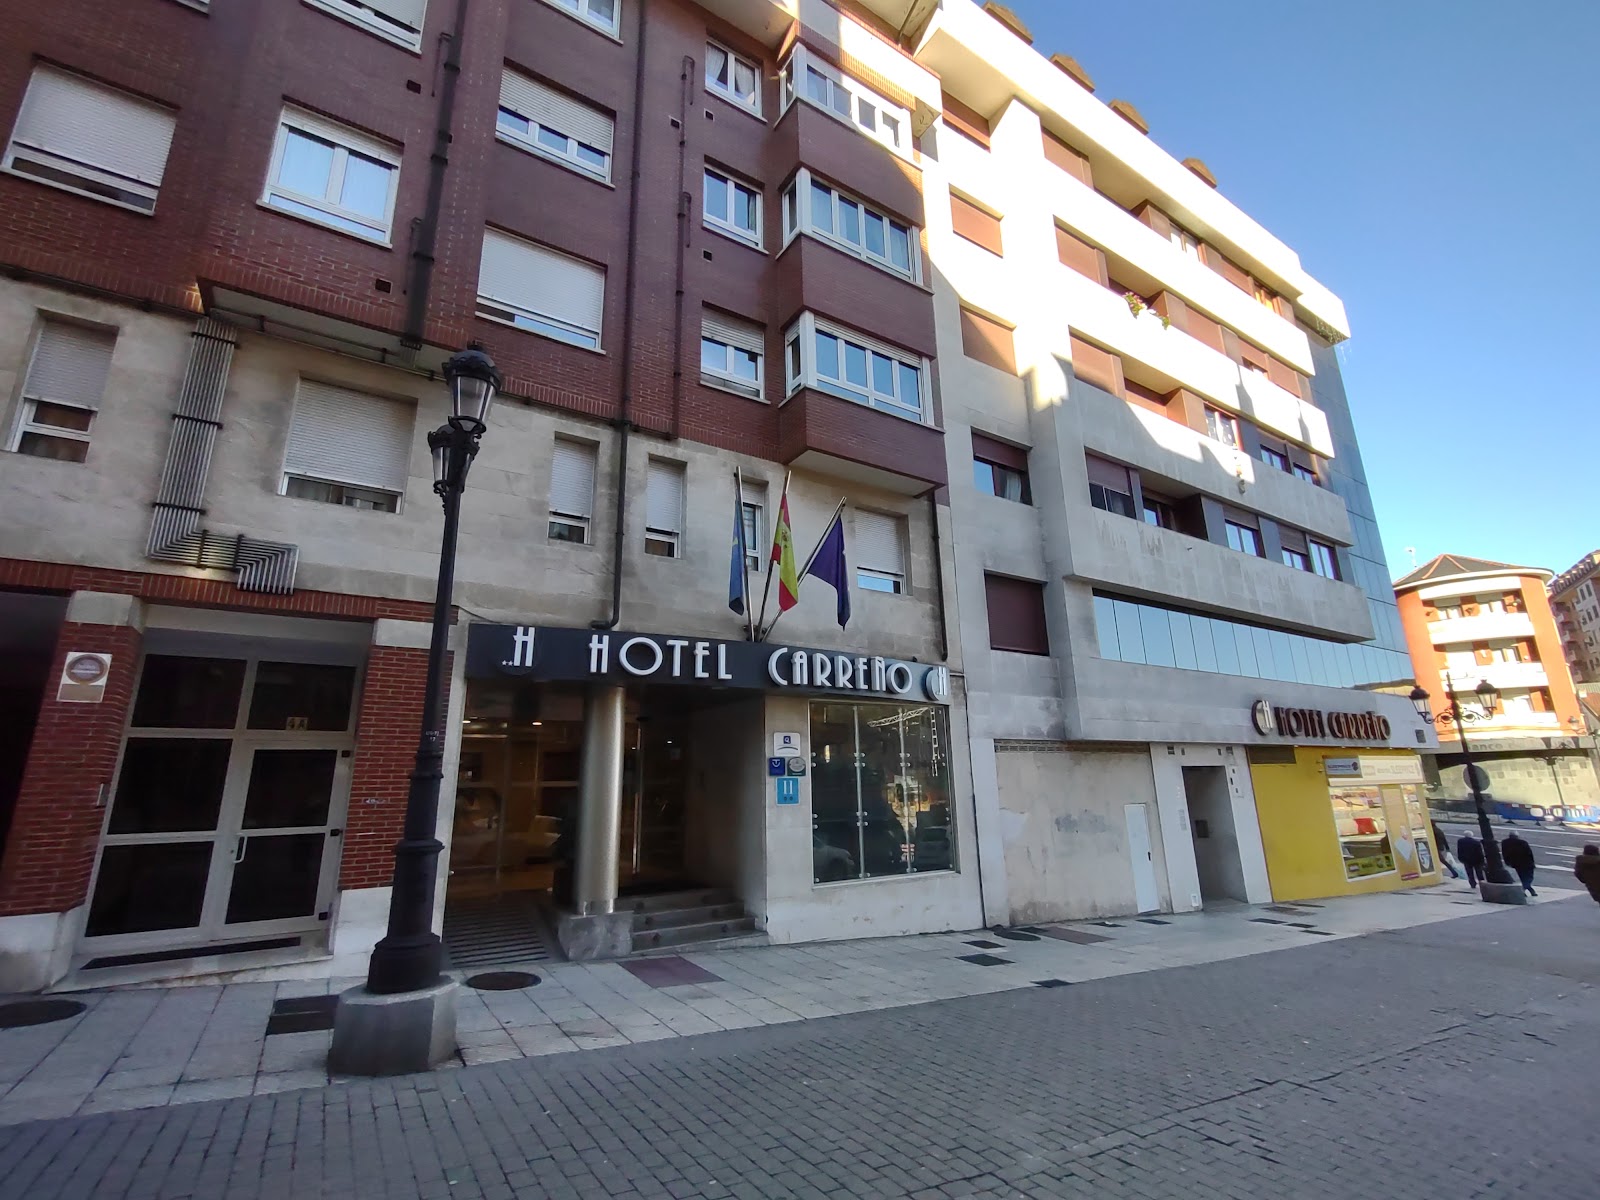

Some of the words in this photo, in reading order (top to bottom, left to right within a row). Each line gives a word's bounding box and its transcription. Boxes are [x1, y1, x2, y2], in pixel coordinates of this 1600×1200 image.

[513, 626, 535, 667] H
[588, 634, 732, 680] HOTEL
[768, 647, 913, 694] CARREÑO
[1273, 706, 1326, 738] HOTEL
[1327, 711, 1391, 741] CARREÑO
[1467, 742, 1504, 752] anco
